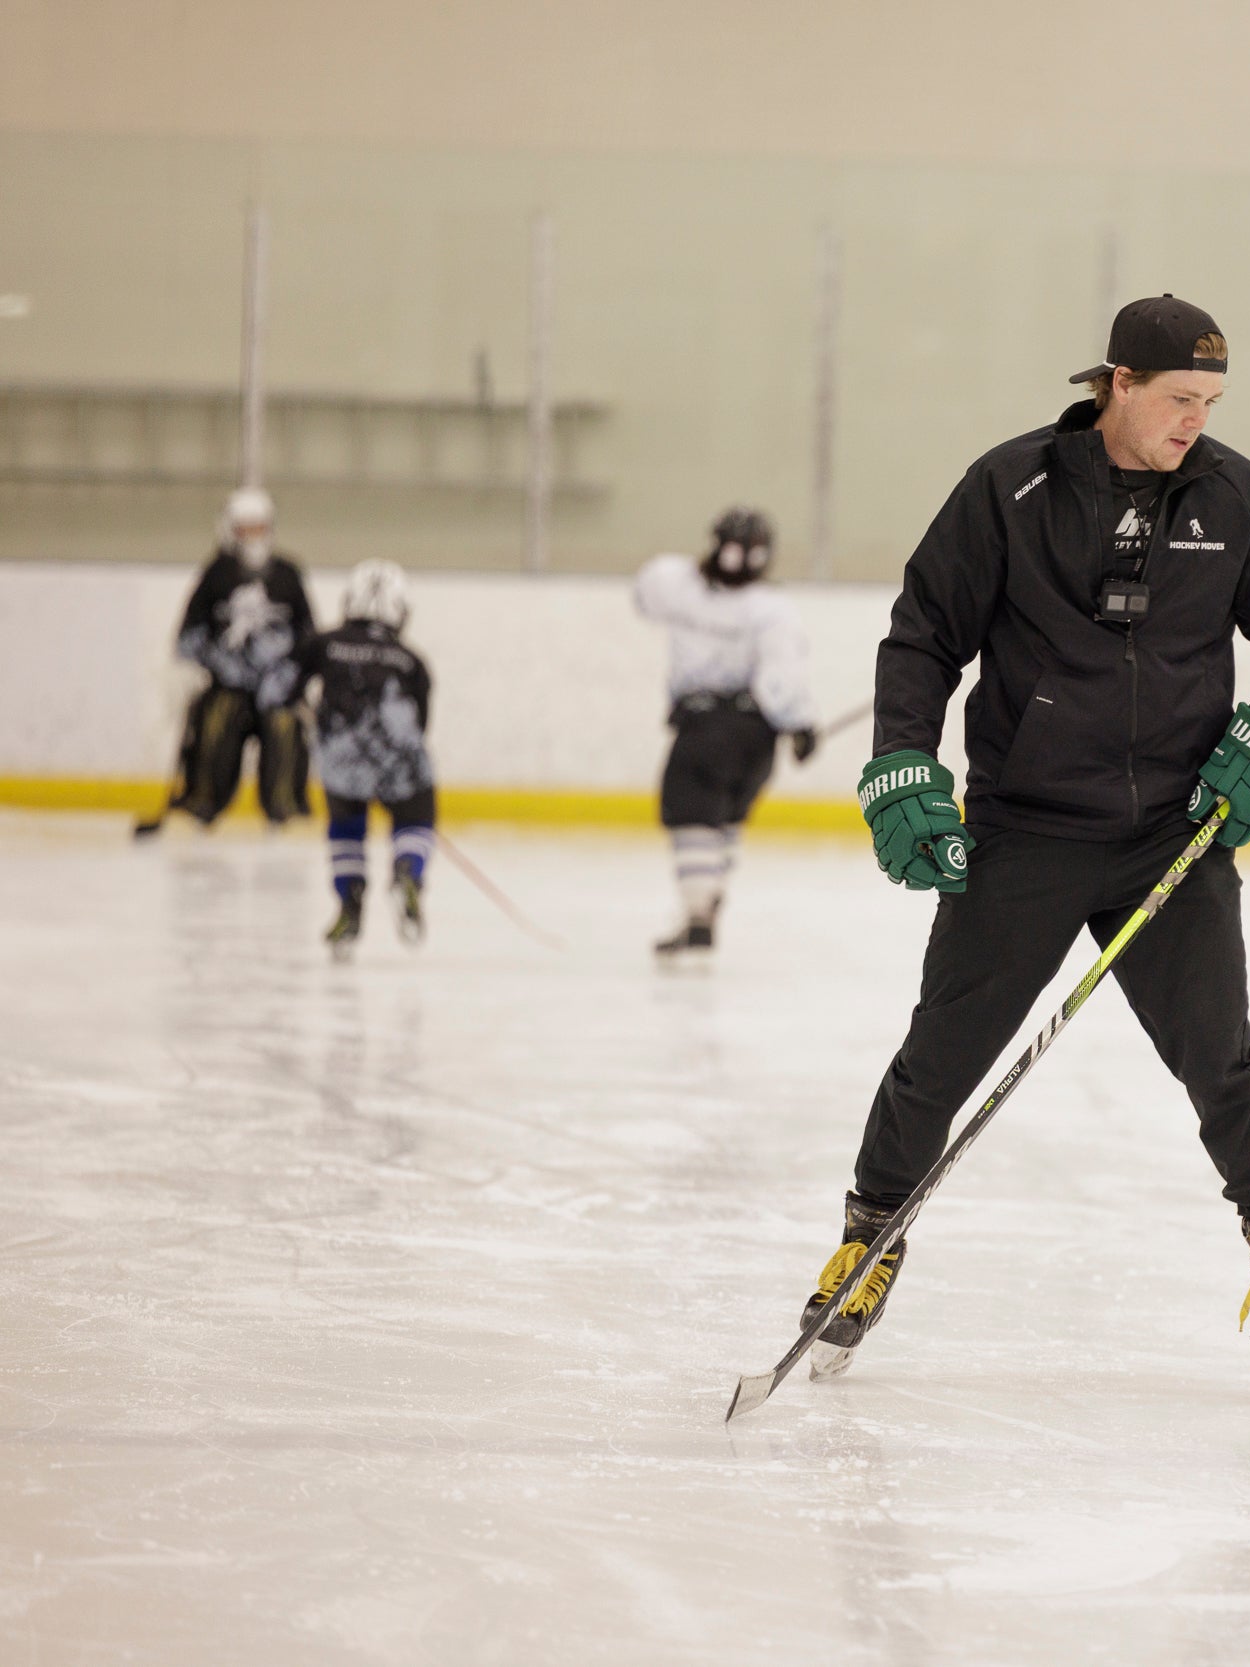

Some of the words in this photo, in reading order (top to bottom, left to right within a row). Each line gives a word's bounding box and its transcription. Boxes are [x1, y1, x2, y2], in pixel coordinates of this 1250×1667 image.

[1014, 472, 1048, 501] BAUER
[1169, 541, 1200, 550] HOCKEY
[1201, 542, 1225, 551] MOVES
[996, 1063, 1021, 1094] ALPHA
